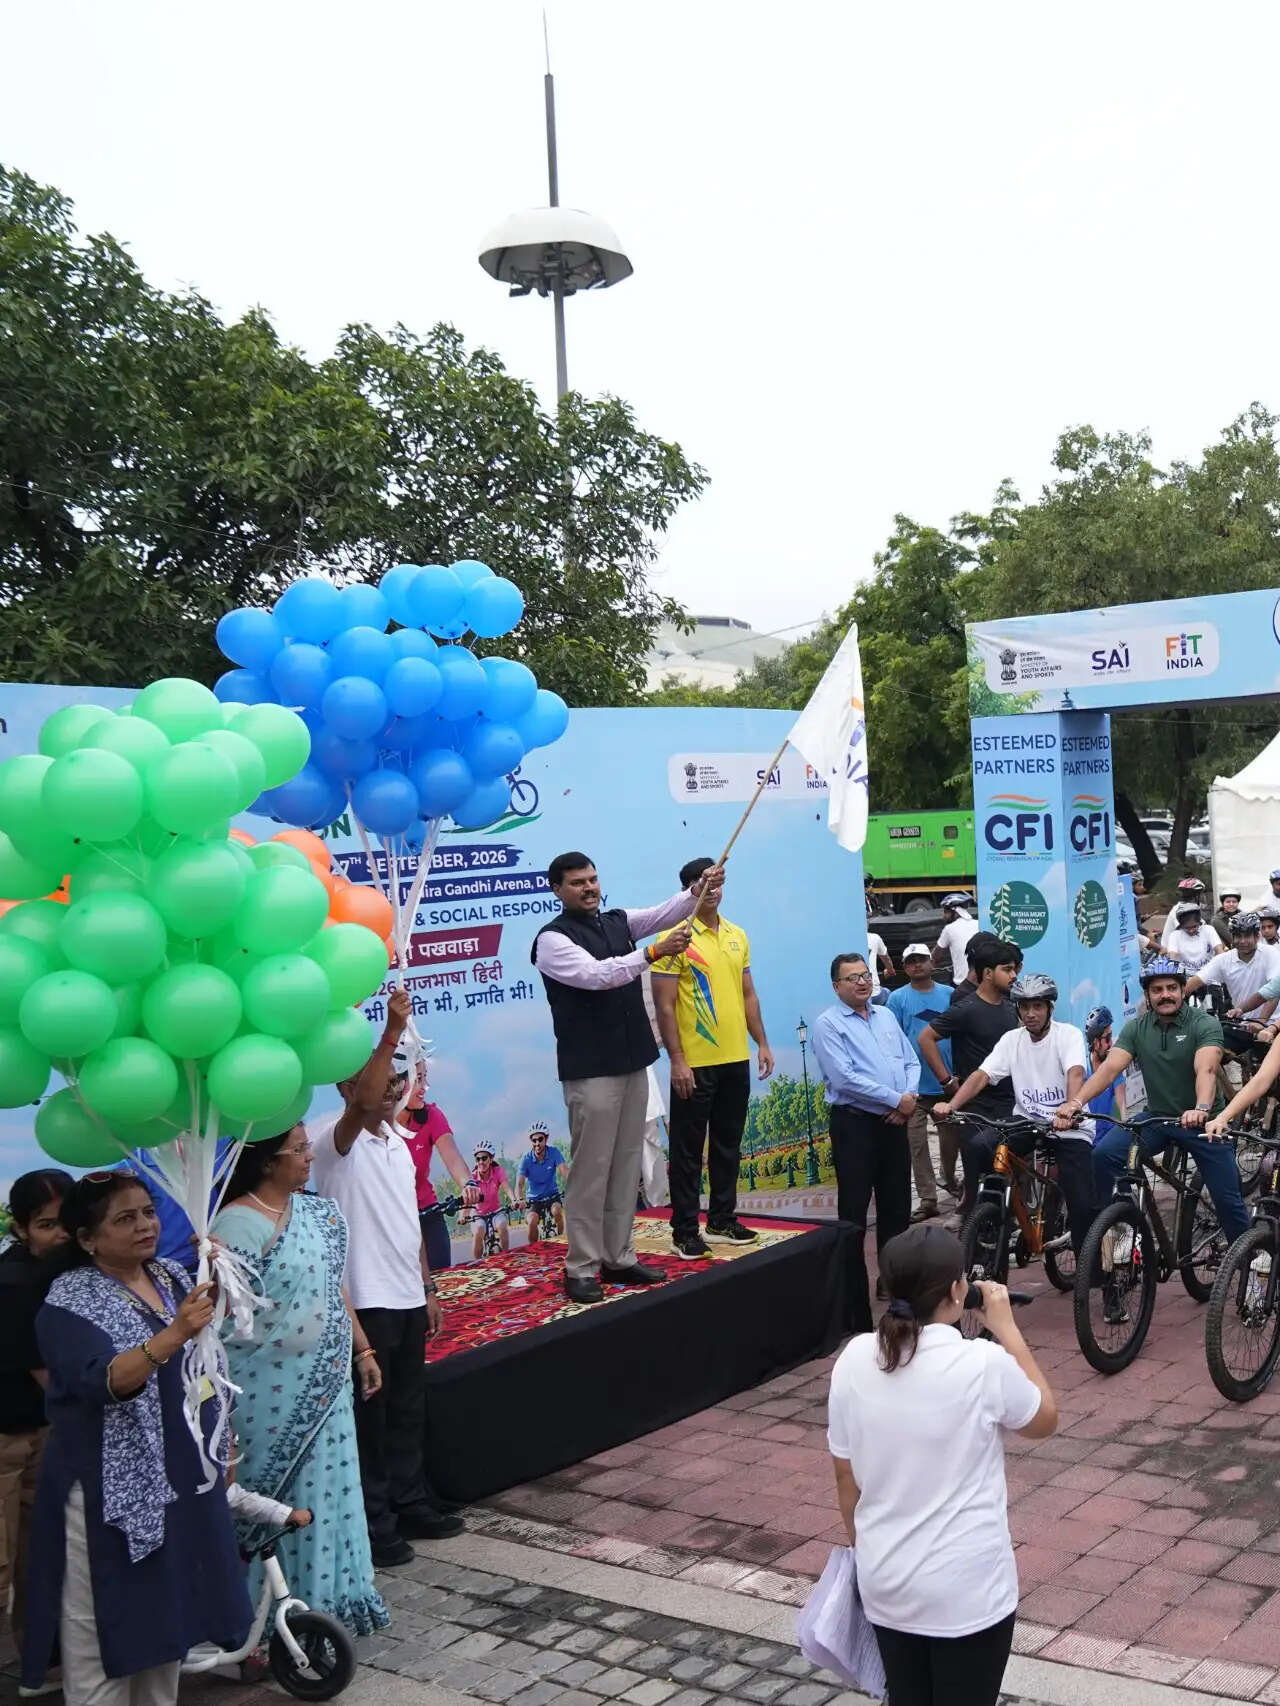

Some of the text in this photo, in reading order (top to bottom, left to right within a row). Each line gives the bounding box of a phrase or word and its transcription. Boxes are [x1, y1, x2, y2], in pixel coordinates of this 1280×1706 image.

[1091, 647, 1130, 671] SAI
[1166, 656, 1204, 670] INDIA
[974, 733, 1056, 751] ESTEEMED
[1062, 736, 1110, 752] ESTEEMED
[974, 758, 1055, 776] PARTNERS
[1063, 759, 1110, 776] PARTNERS
[807, 780, 828, 789] INDIA
[984, 813, 1054, 851] CFI
[1070, 812, 1110, 852] CFI
[366, 852, 468, 873] SETEBER,
[470, 850, 508, 866] 2026
[444, 879, 491, 896] Gandhi
[493, 878, 535, 892] Arena,
[415, 912, 425, 926] &
[430, 906, 488, 925] SOCIAL
[418, 937, 480, 957] पखवाड़ा
[403, 970, 467, 992] राजभाषा
[472, 960, 503, 983] हिंदी
[411, 995, 428, 1016] ति
[464, 985, 505, 1008] प्रगति
